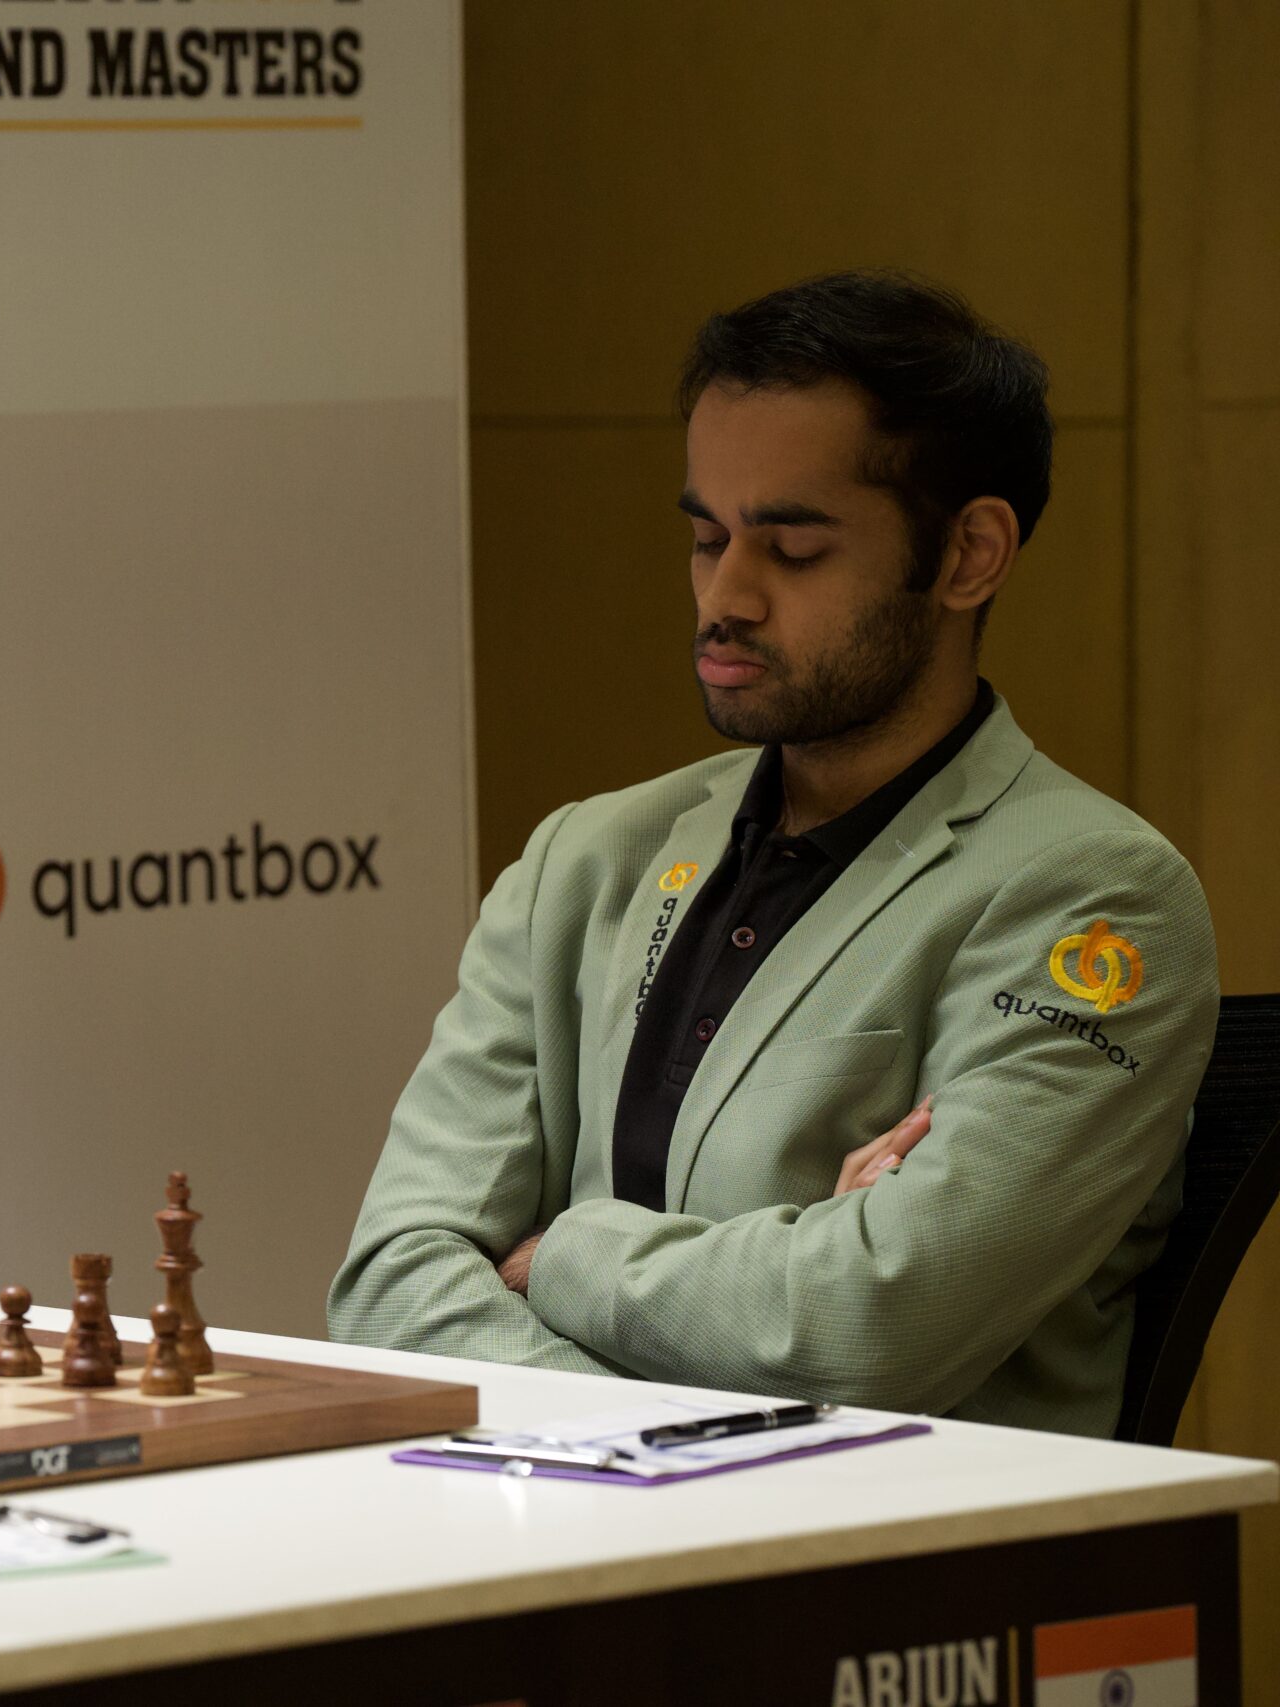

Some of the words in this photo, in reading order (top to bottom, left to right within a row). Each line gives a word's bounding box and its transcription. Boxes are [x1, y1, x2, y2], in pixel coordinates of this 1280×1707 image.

[88, 27, 363, 98] MASTERS
[32, 821, 381, 939] quantbox
[993, 991, 1140, 1077] quantbox
[832, 1637, 997, 1707] ARJUN
